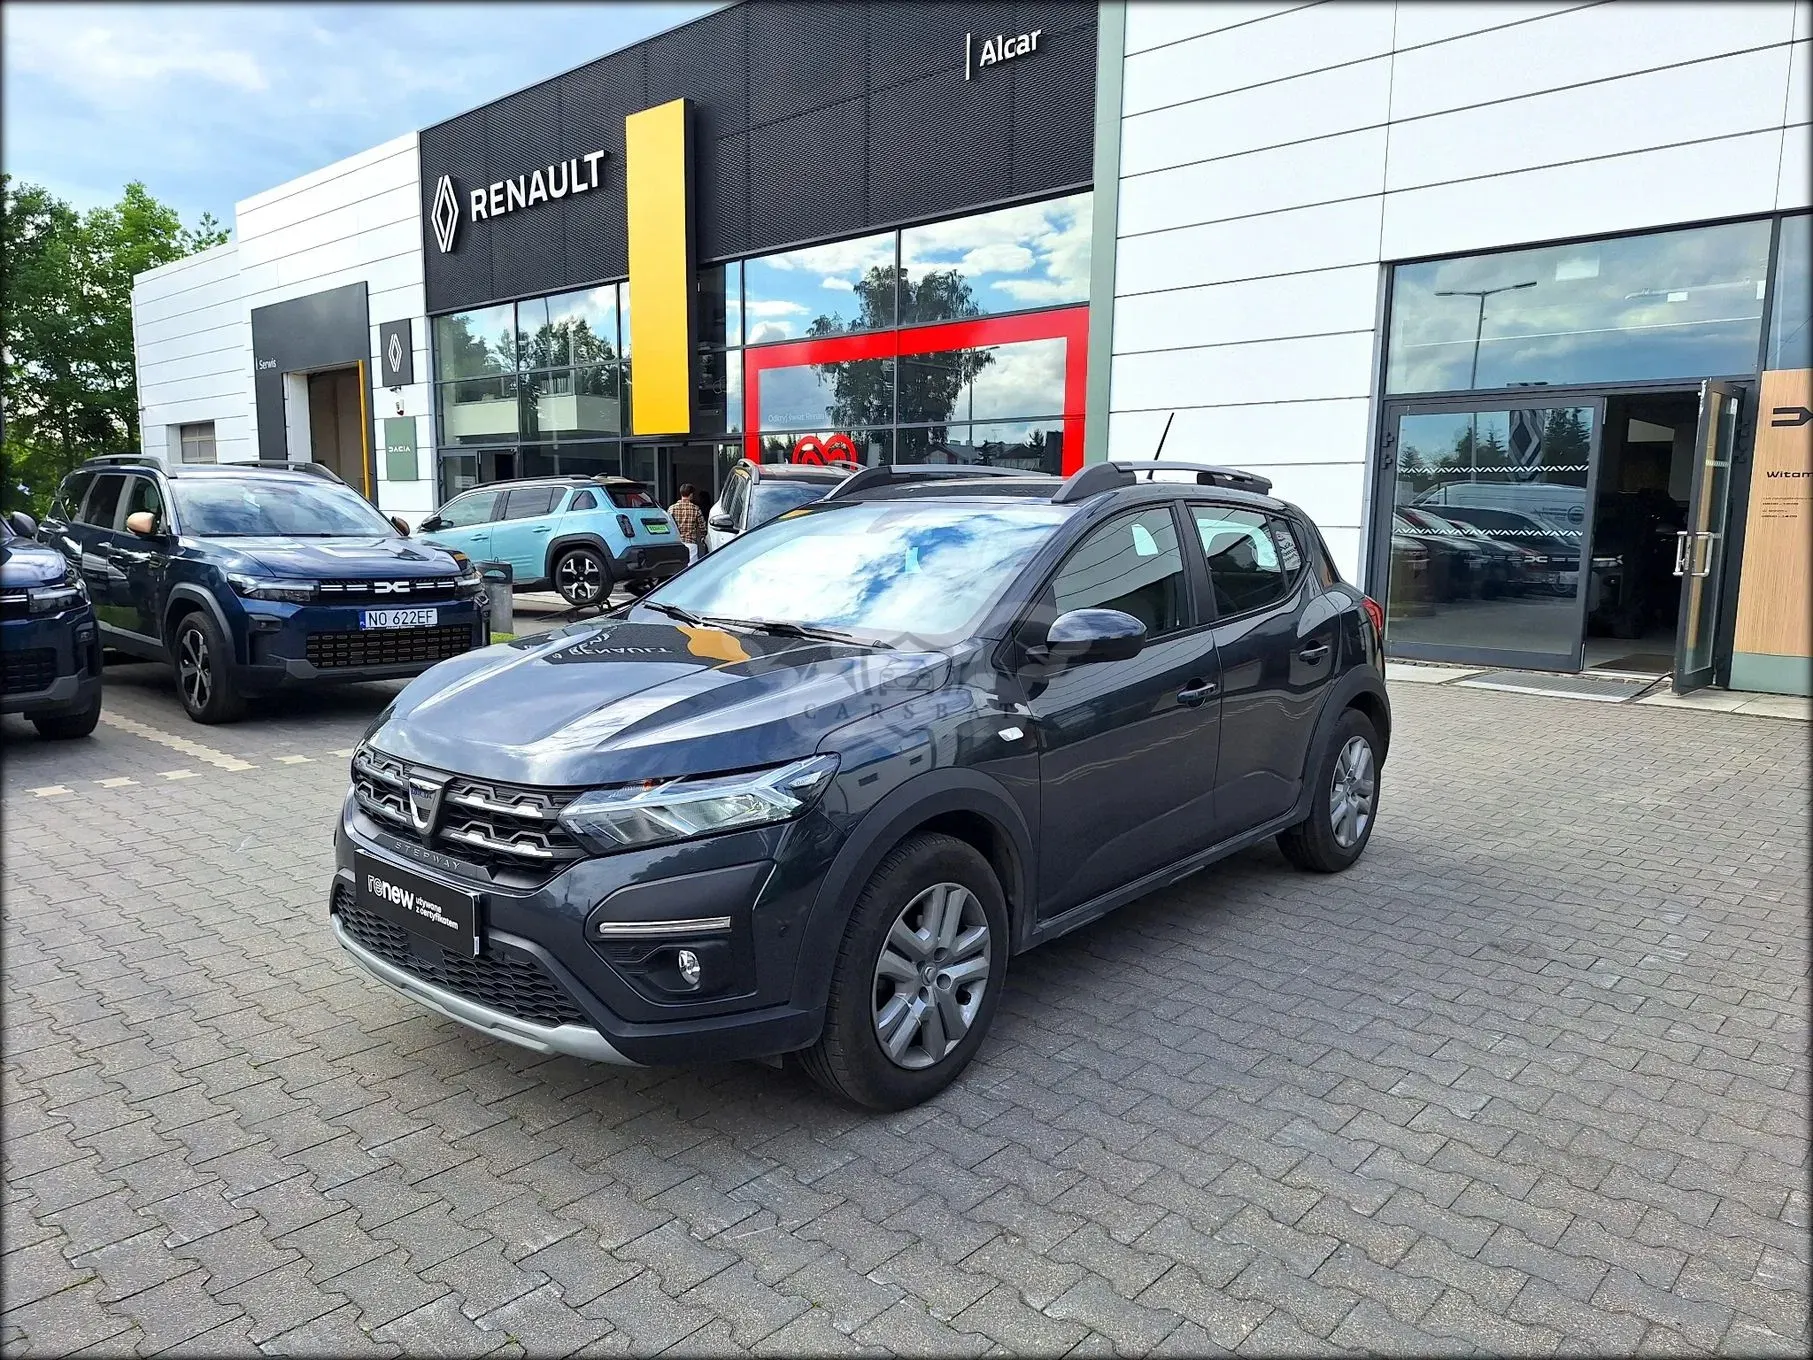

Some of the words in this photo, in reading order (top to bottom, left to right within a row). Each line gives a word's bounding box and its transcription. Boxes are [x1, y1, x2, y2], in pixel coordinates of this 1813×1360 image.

[980, 29, 1041, 67] Alcar
[470, 150, 604, 222] RENAULT
[259, 357, 276, 370] Serwis
[393, 609, 433, 625] 622EF
[395, 841, 460, 869] STEPWAY
[367, 874, 414, 910] renew
[420, 908, 459, 930] certyfikatem
